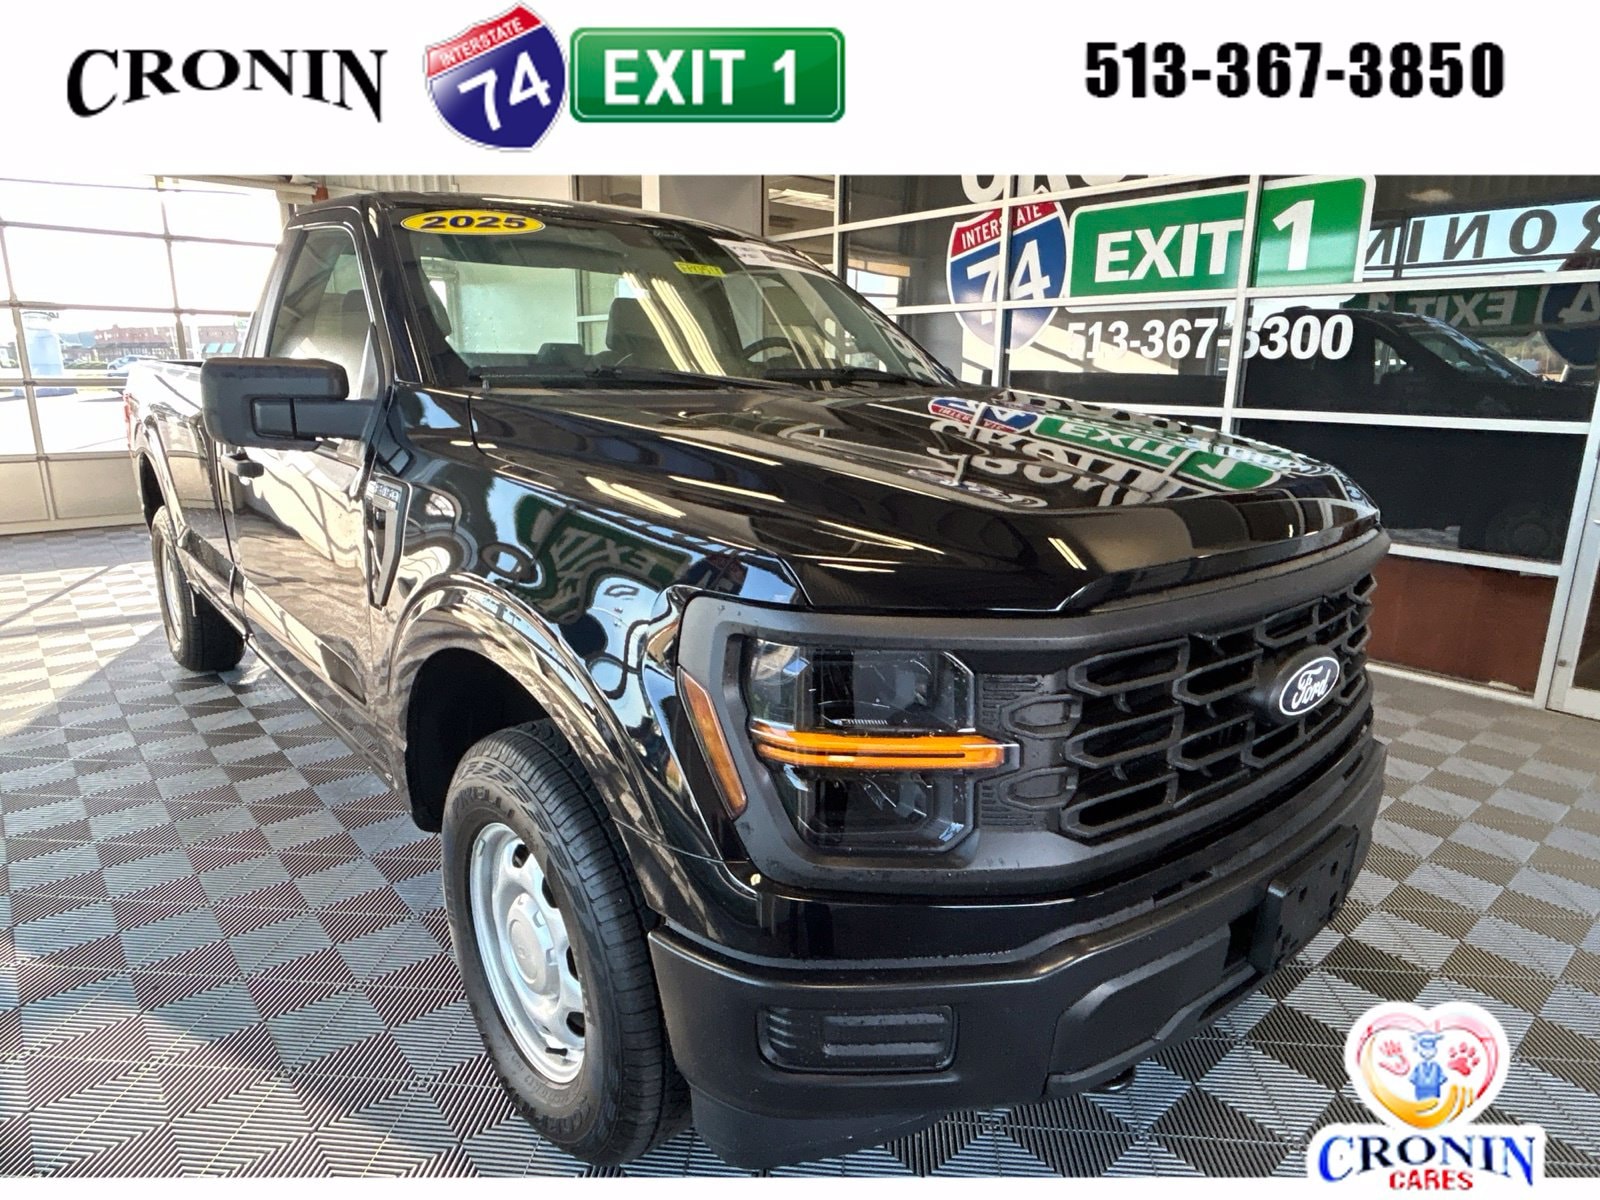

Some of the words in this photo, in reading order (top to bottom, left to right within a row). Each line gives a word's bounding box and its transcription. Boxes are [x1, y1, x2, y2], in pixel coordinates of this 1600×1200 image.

[420, 215, 527, 229] 2025
[961, 203, 1043, 250] INTERATE
[1094, 218, 1244, 283] EXIT
[1272, 199, 1315, 271] 1
[966, 239, 1051, 326] 74
[1291, 665, 1331, 710] Ford
